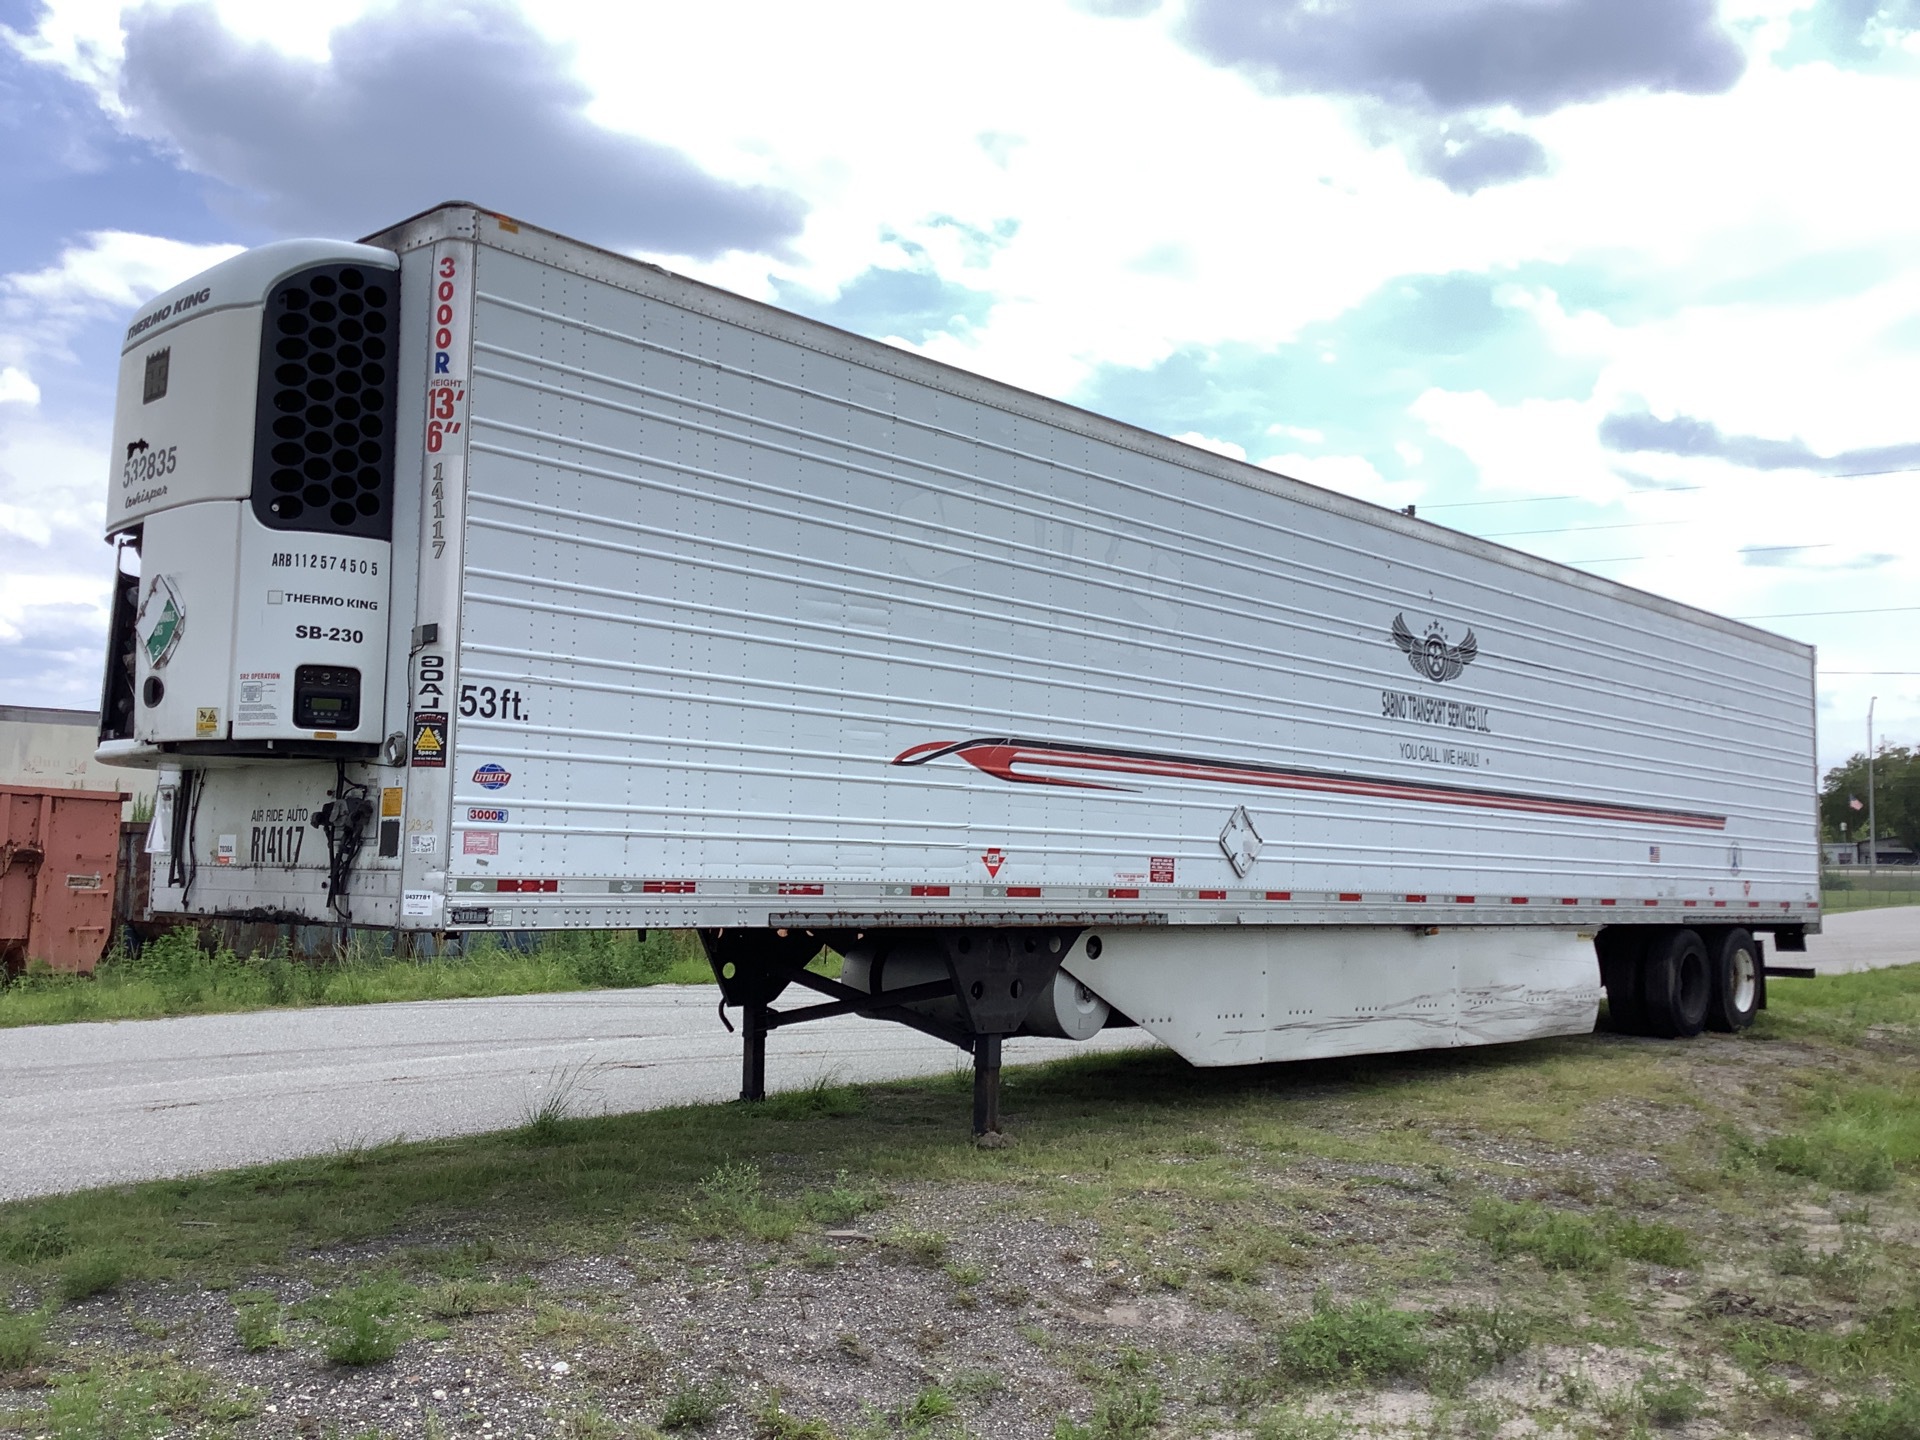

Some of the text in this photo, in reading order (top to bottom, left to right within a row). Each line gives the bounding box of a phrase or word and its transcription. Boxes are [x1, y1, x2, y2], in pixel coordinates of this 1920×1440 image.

[127, 287, 210, 340] THERMO KING
[431, 378, 462, 388] HEIGHT
[428, 387, 465, 420] 13'
[432, 462, 446, 559] 14117
[285, 593, 378, 611] THERMO KING
[295, 625, 364, 644] SB-230
[153, 645, 160, 656] 2
[251, 672, 281, 680] OPERATION
[459, 685, 528, 721] 53ft.
[1382, 691, 1491, 733] SABINO TRANSPORT SERVICES LLC
[1400, 742, 1417, 760] YOU
[1442, 748, 1455, 765] WE
[474, 773, 509, 782] UTILITY
[251, 808, 308, 822] AIR RIDE AUTO
[250, 826, 305, 863] R14117
